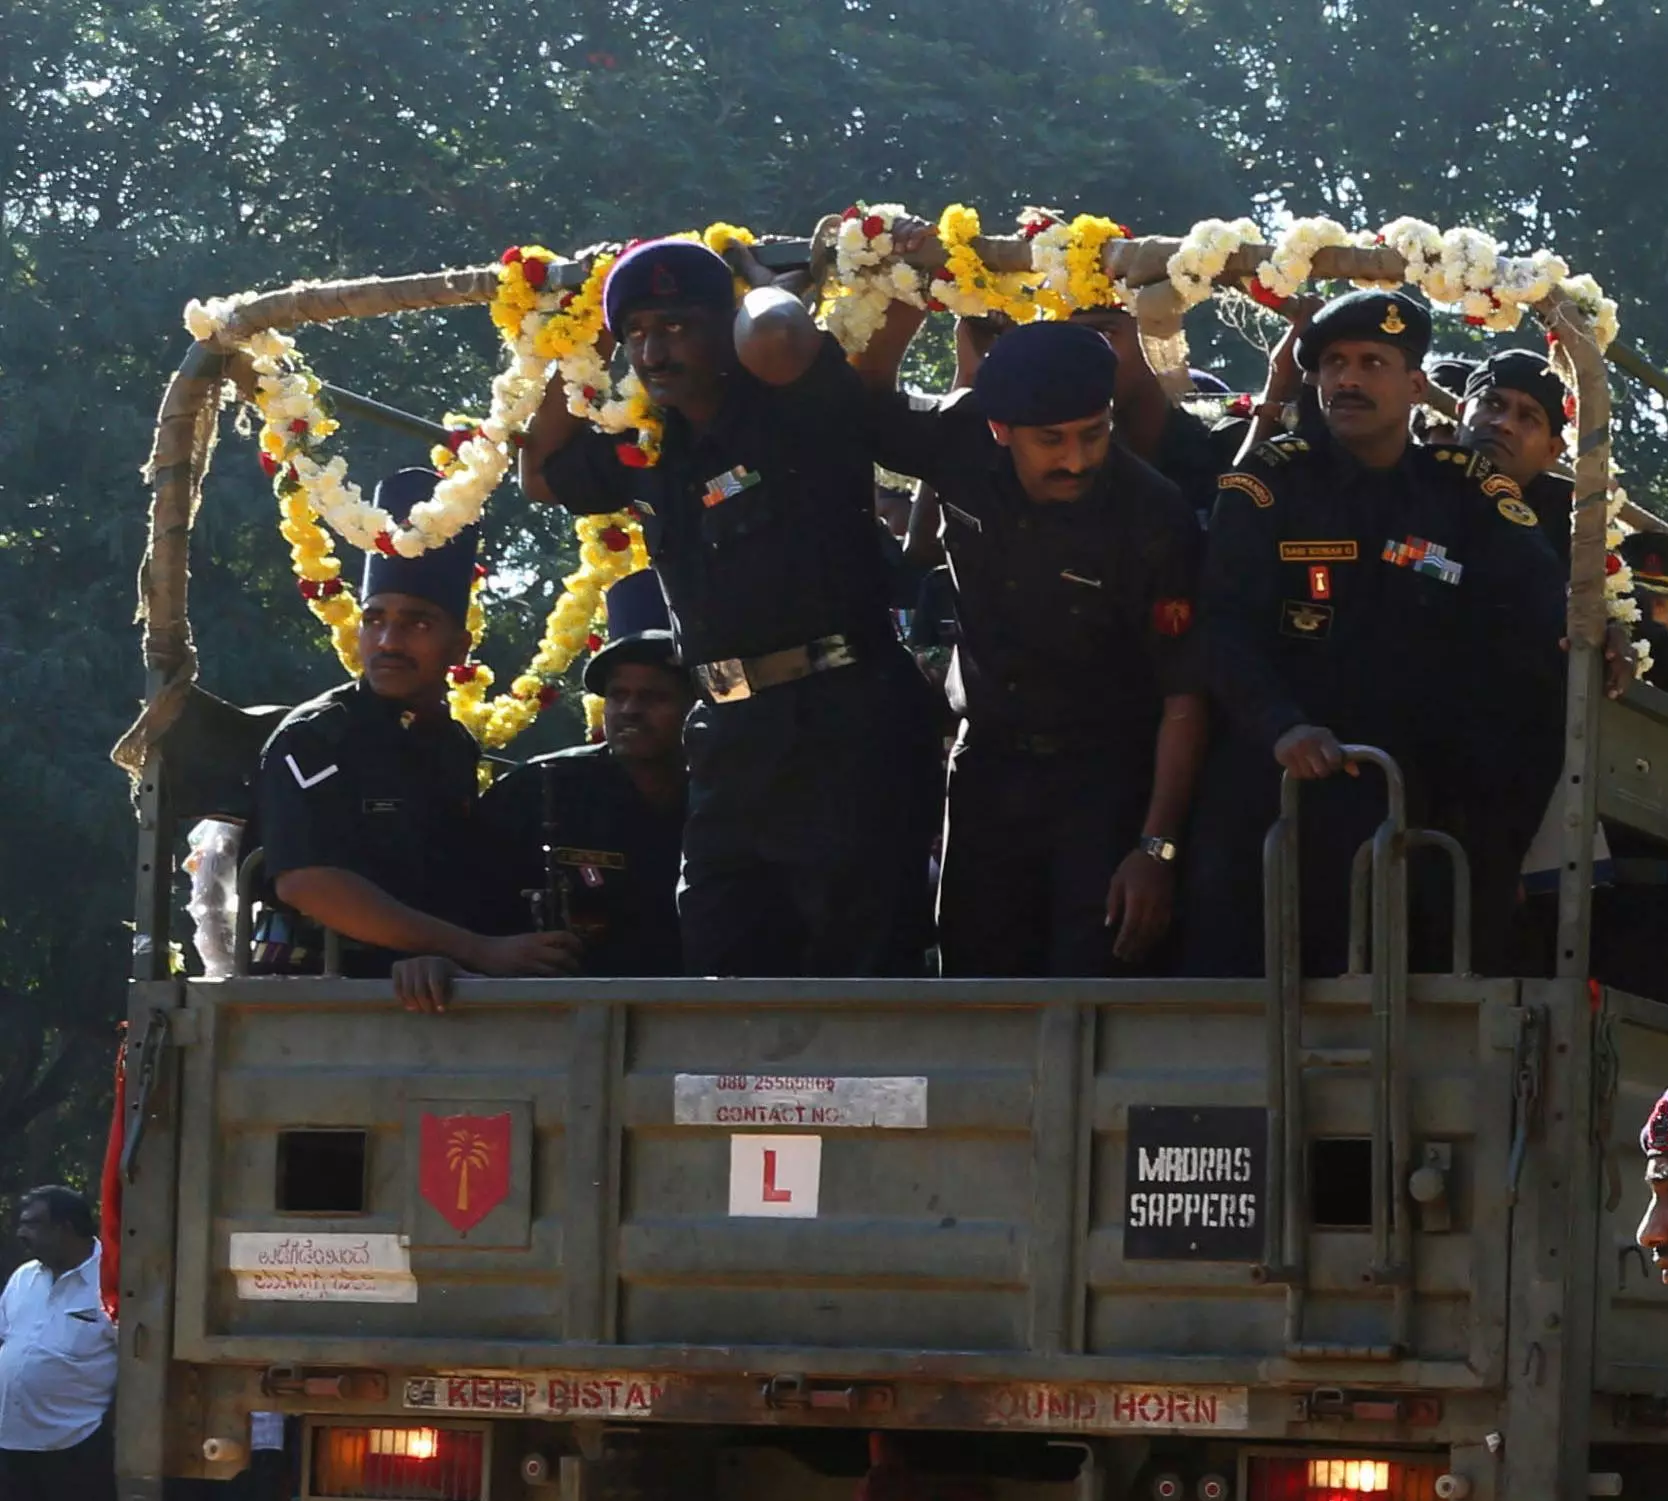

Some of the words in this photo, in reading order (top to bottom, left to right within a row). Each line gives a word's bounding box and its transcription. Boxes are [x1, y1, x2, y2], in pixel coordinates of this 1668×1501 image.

[762, 1150, 792, 1202] L
[1138, 1147, 1251, 1182] MADRAS
[1129, 1193, 1256, 1228] SAPPERS
[1113, 1392, 1217, 1424] HORN
